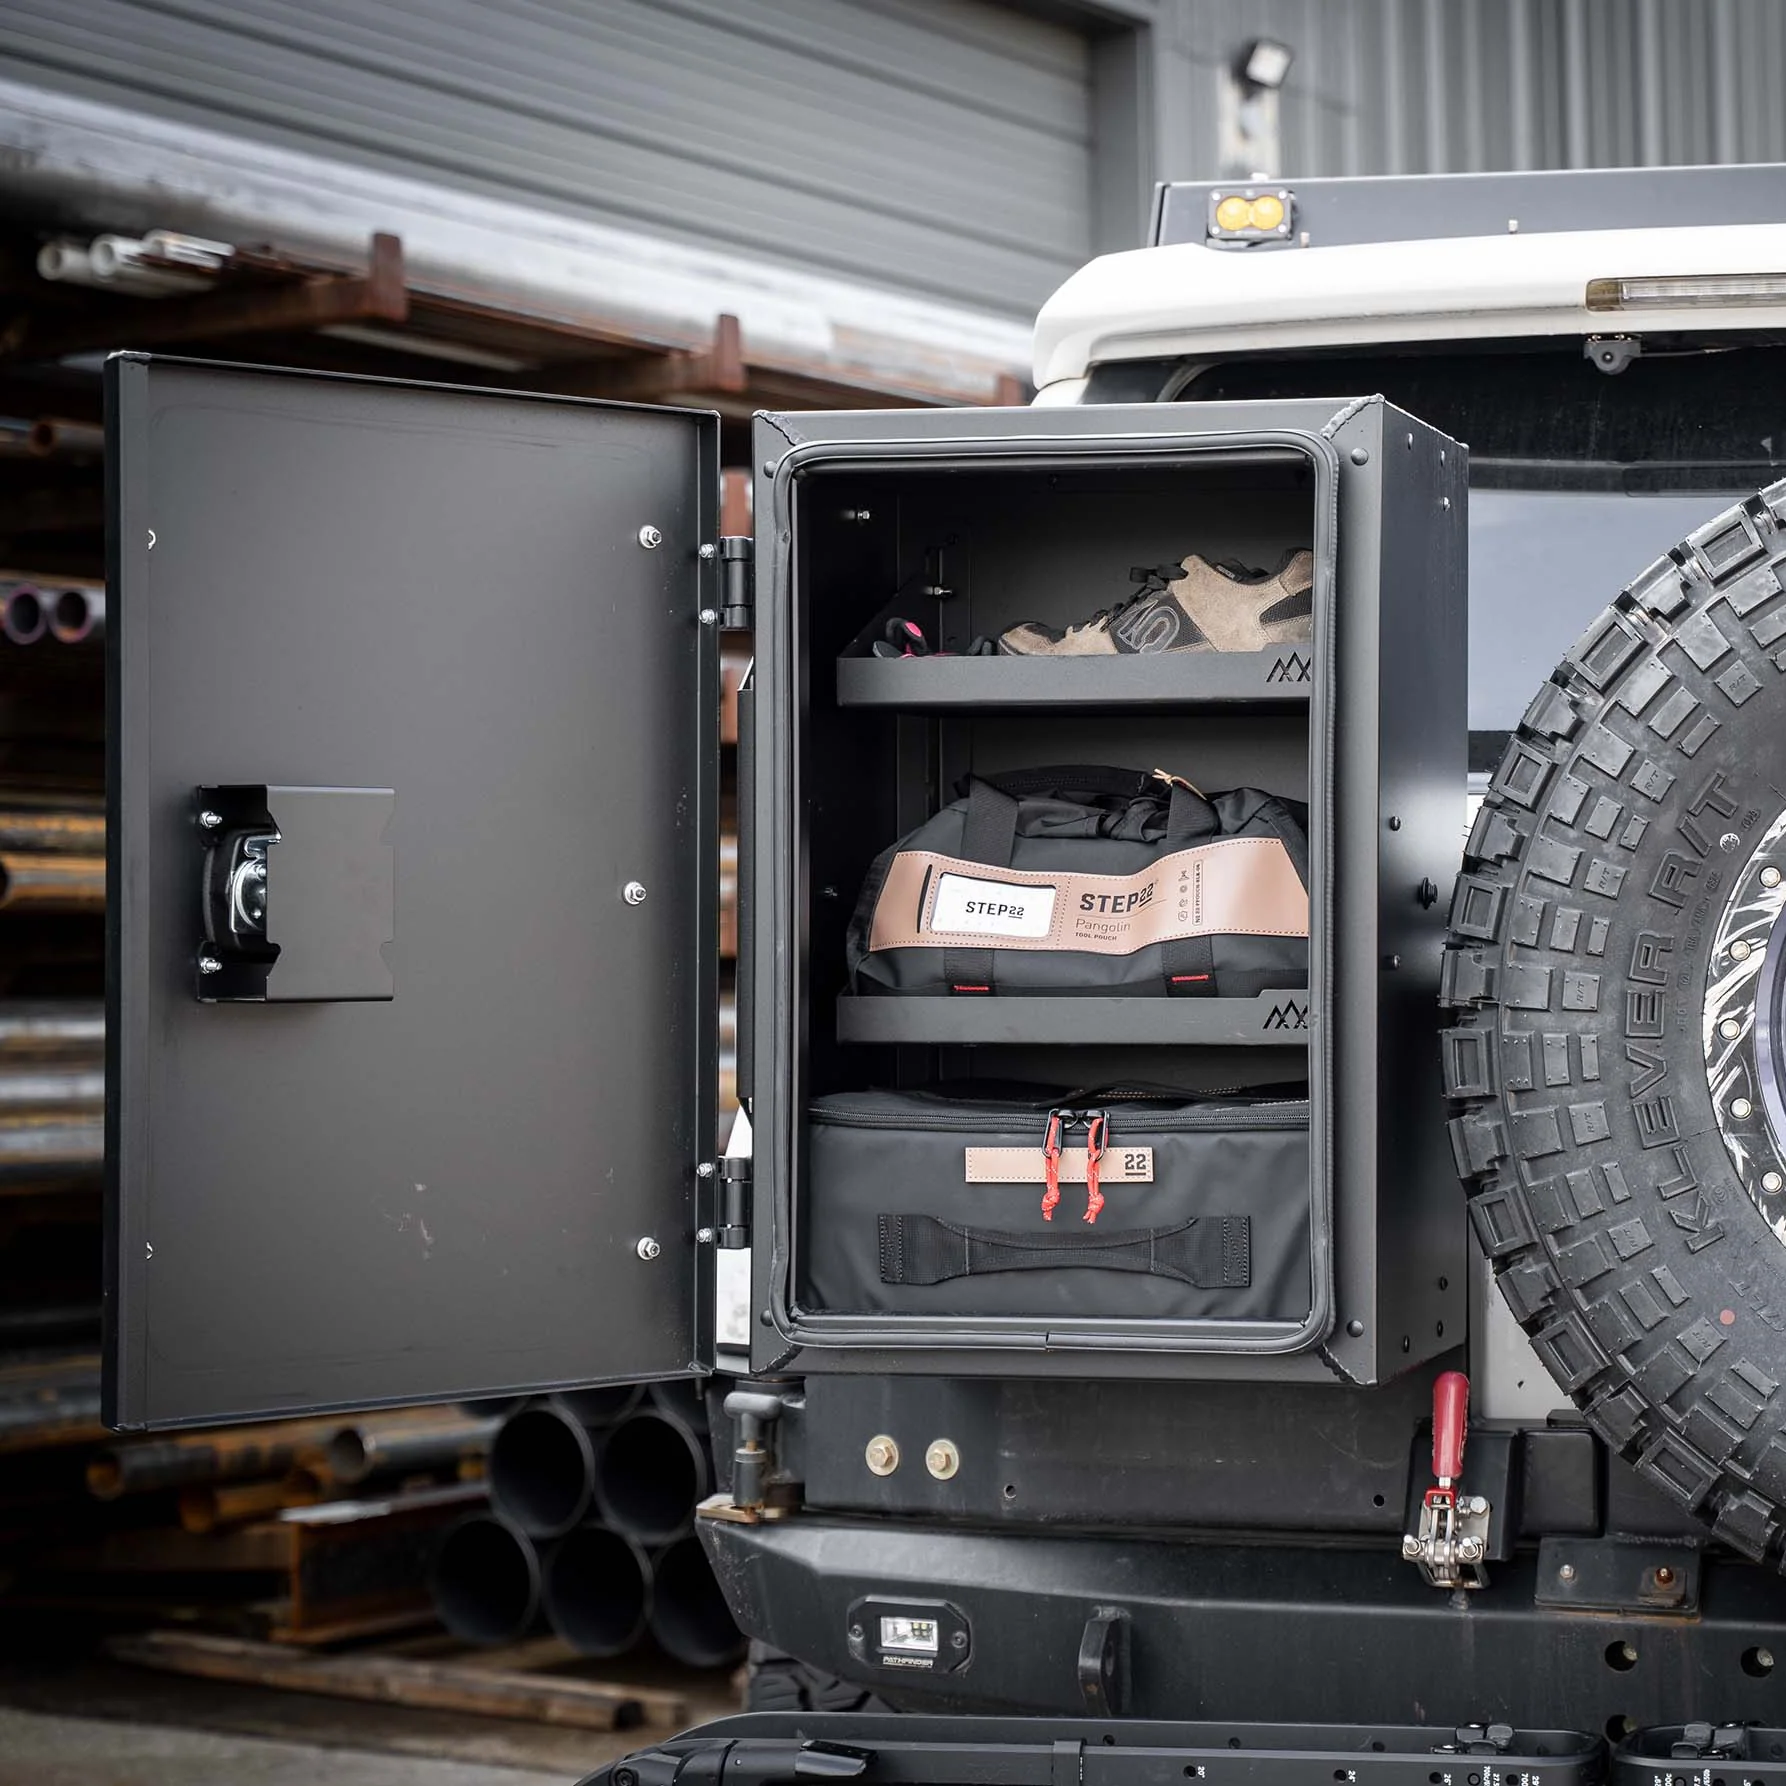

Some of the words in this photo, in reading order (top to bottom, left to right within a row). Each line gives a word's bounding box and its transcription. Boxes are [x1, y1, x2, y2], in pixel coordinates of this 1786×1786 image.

[1648, 769, 1740, 908] R/T
[1075, 918, 1131, 934] Pangolin
[1075, 931, 1091, 939] TOOL
[1624, 930, 1725, 1254] KLEVER
[1125, 1154, 1147, 1171] 22
[882, 1656, 933, 1668] PATHFINDER
